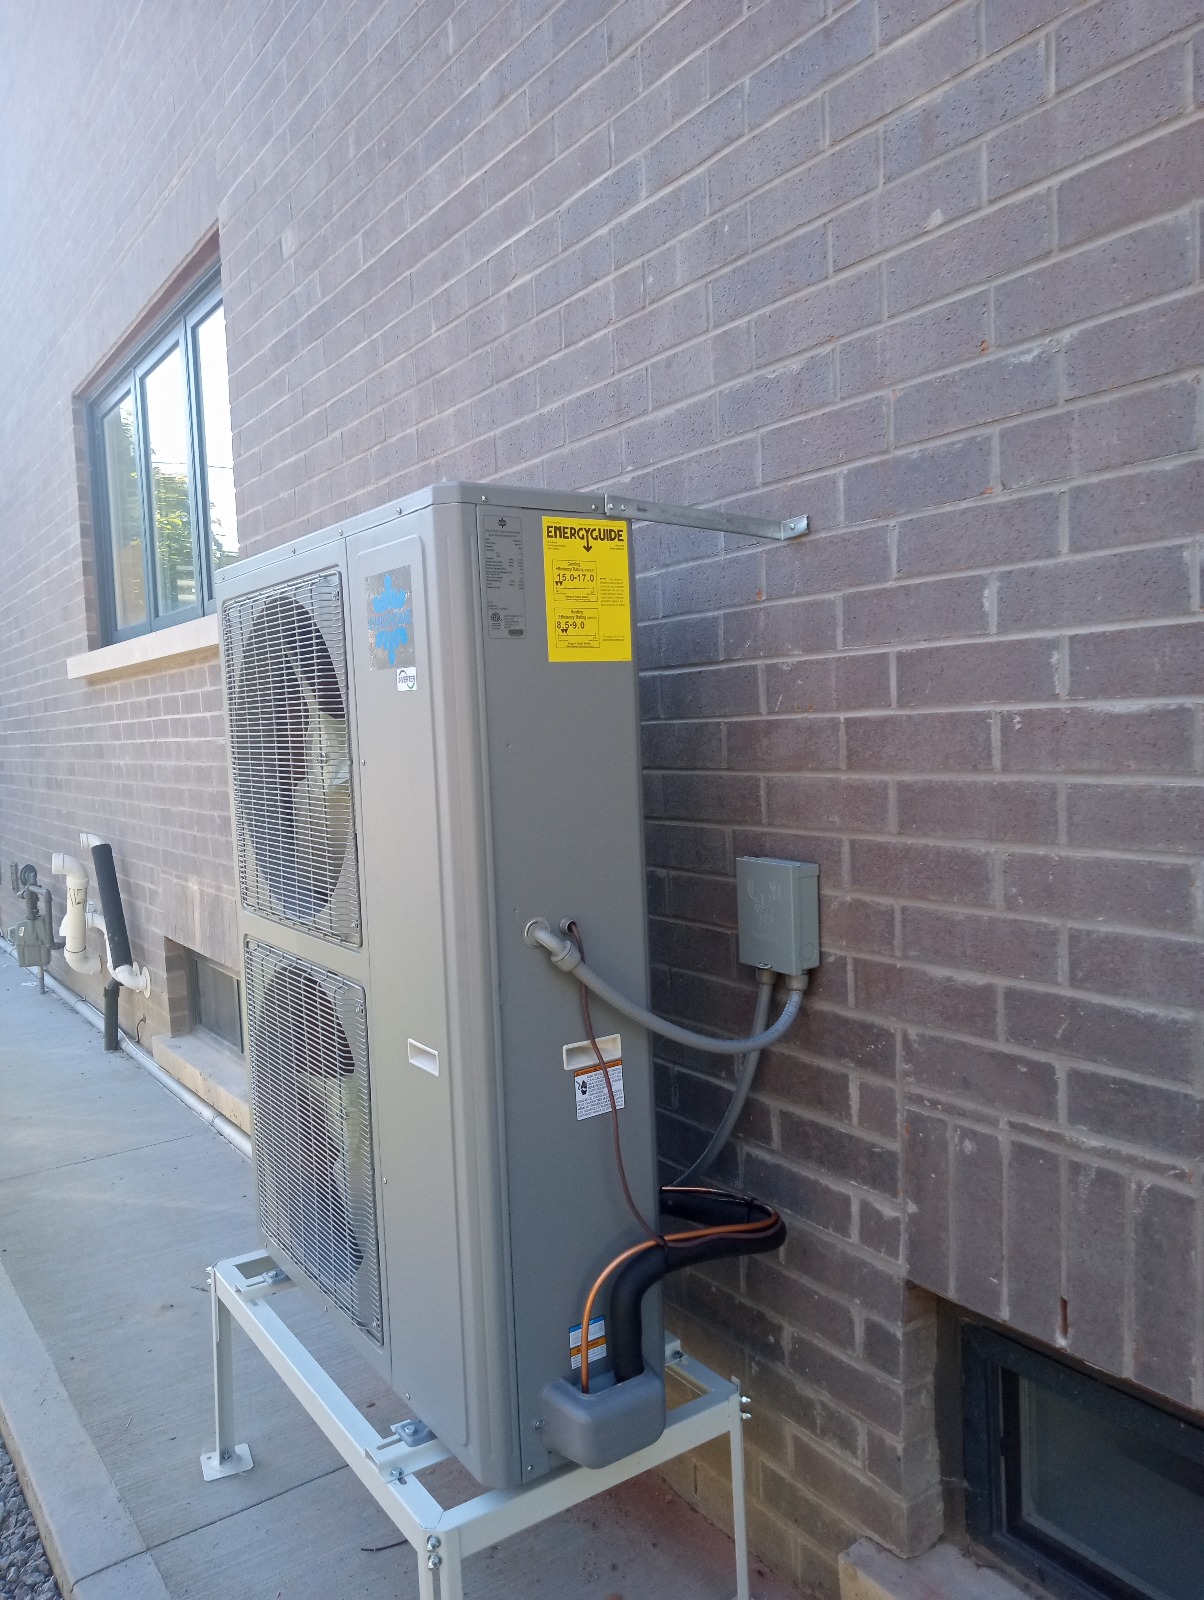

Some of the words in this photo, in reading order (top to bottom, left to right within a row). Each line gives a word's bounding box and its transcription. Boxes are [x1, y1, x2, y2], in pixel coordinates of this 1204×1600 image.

[546, 525, 624, 542] ENERGYGUIDE
[556, 573, 595, 582] 15.0-17.0
[556, 620, 585, 629] 8.5-9.0
